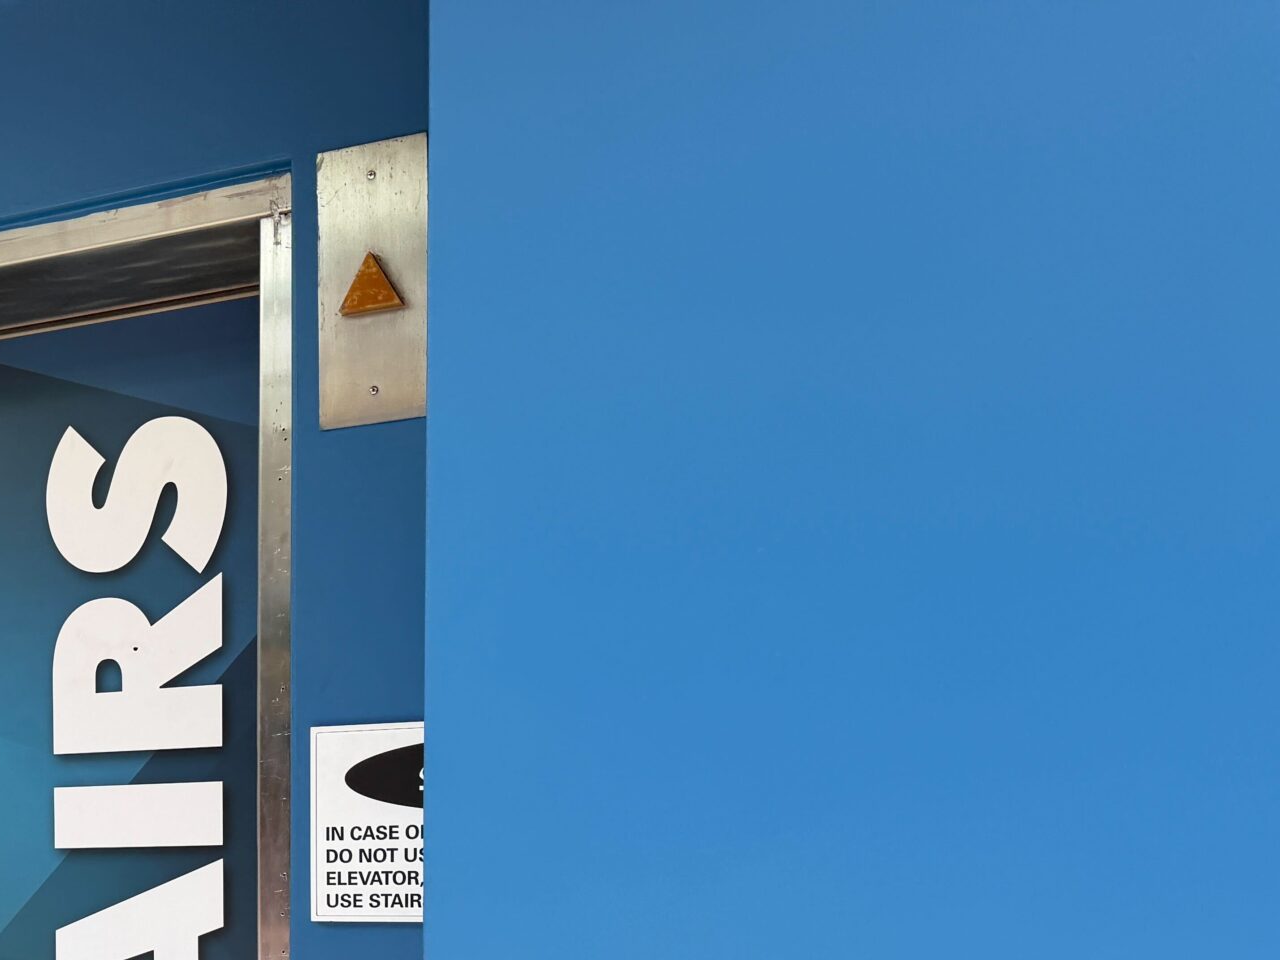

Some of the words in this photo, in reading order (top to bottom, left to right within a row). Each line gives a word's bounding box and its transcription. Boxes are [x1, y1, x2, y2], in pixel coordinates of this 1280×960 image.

[326, 826, 344, 841] IN
[350, 825, 399, 840] CASE
[405, 824, 424, 840] O
[326, 849, 352, 863] DO
[359, 848, 398, 863] NOT
[326, 893, 363, 908] USE
[369, 893, 424, 908] STAIR
